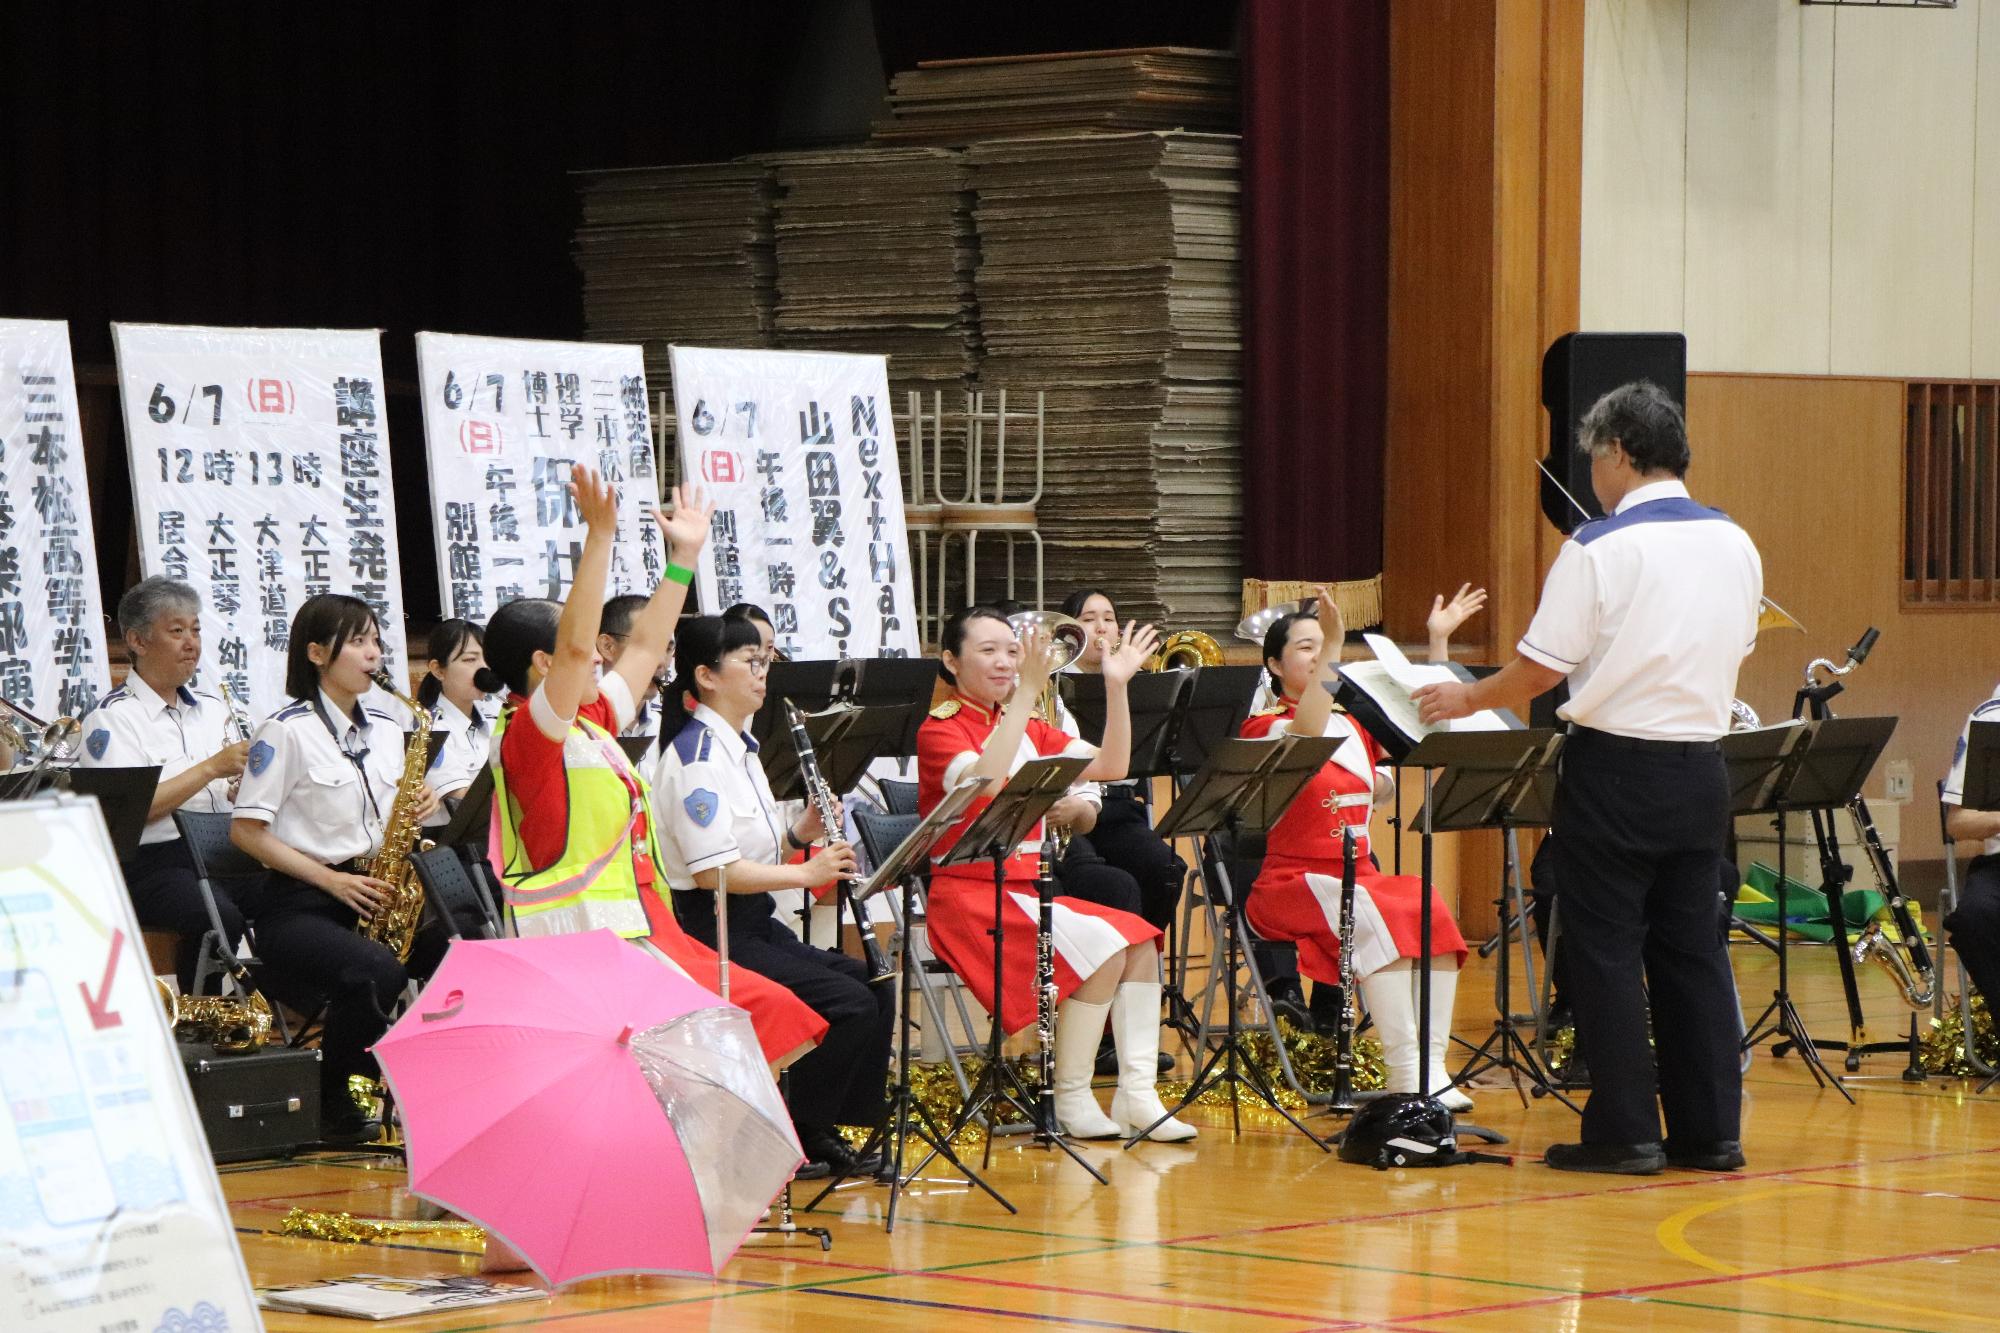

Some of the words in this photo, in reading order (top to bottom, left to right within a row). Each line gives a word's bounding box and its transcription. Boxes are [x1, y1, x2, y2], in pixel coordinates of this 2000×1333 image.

[148, 382, 225, 426] 6/7
[444, 370, 505, 413] 6/7
[692, 399, 758, 439] 6/7
[22, 375, 98, 722] 三本松高等学校
[253, 512, 289, 653] 大津道場
